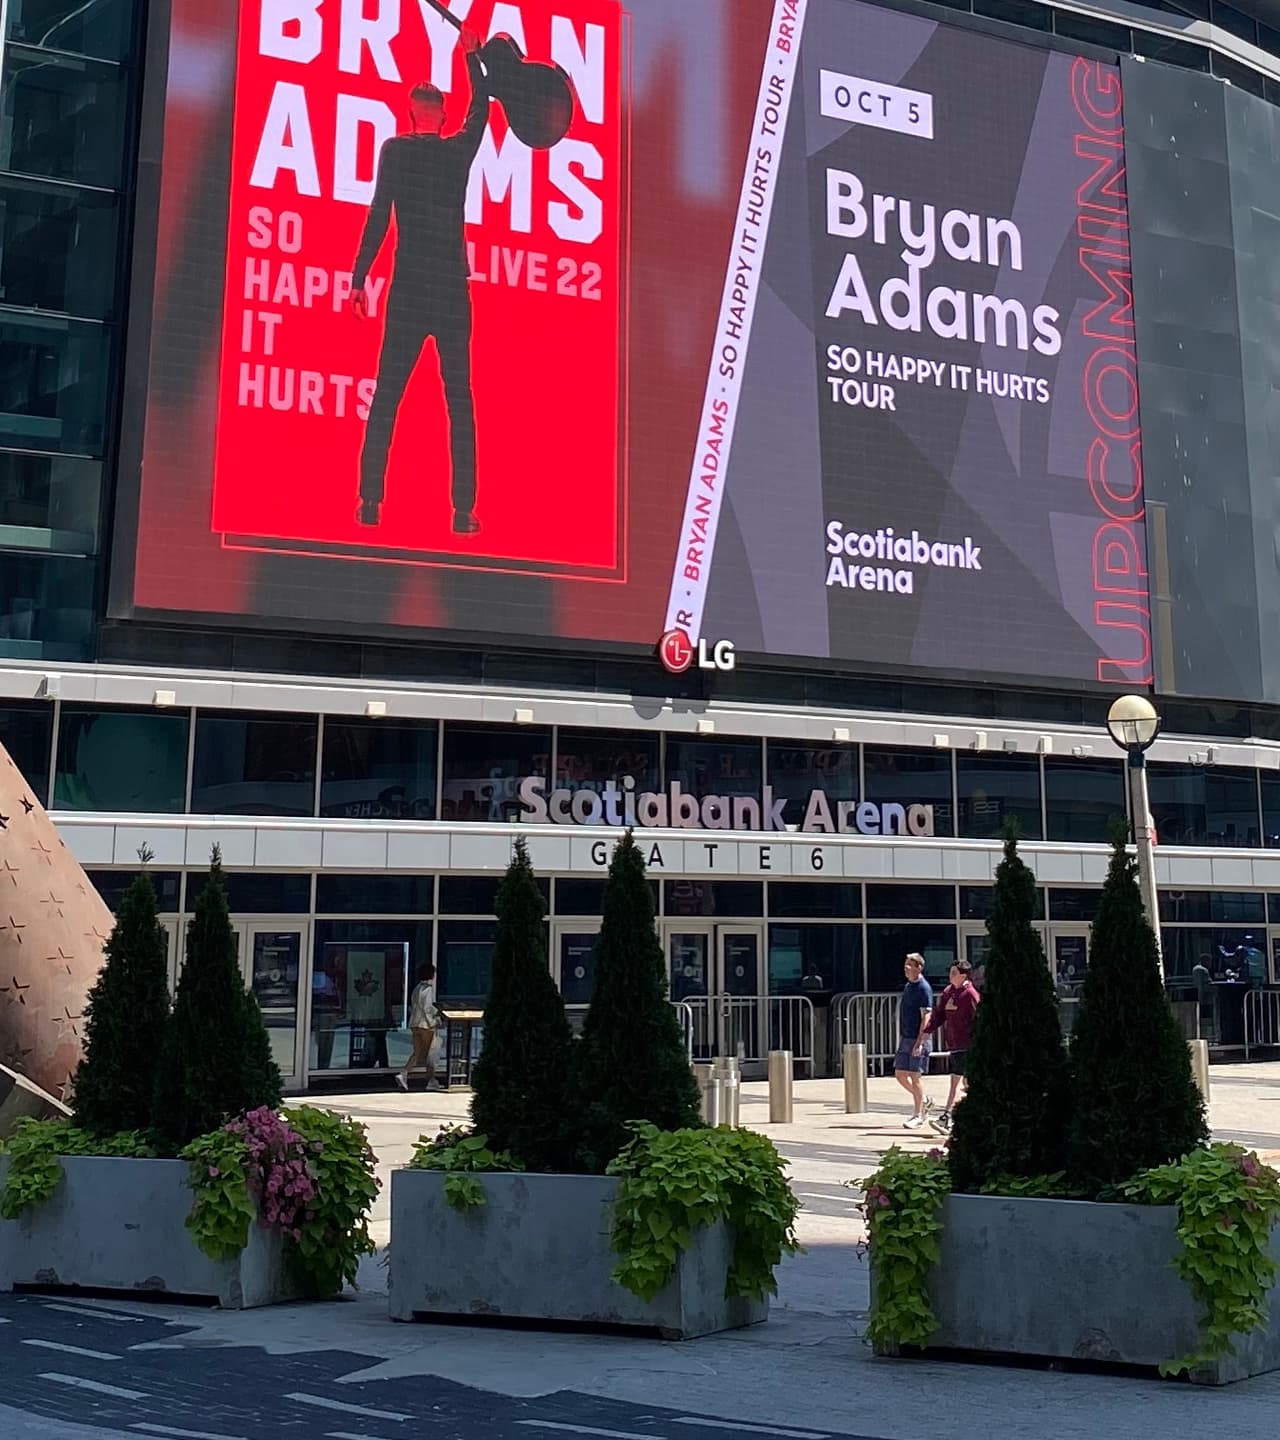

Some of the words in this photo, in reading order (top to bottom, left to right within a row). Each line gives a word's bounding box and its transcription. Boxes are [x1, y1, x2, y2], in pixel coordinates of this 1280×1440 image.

[761, 74, 785, 137] TOUR
[834, 85, 892, 119] OCT
[907, 102, 921, 124] 5
[249, 80, 604, 245] ADMS
[745, 147, 772, 227] HURTS
[247, 205, 303, 254] SO
[742, 229, 758, 254] IT
[826, 168, 1023, 270] Bryan
[243, 256, 386, 318] HAPPY
[466, 240, 549, 292] LIVE
[557, 257, 602, 301] 22
[725, 256, 754, 340] HAPPY
[241, 310, 282, 356] IT
[825, 253, 1062, 356] Adams
[237, 363, 378, 421] HURTS
[719, 344, 738, 380] SO
[827, 344, 861, 373] SO
[866, 350, 946, 387] HAPPY
[950, 364, 971, 391] IT
[976, 368, 1050, 404] HURTS
[1071, 56, 1155, 686] UPCOMING
[827, 376, 896, 411] TOUR
[700, 398, 729, 492] ADAMS
[683, 494, 713, 582] BRYAN
[826, 520, 982, 570] Scotiabank
[826, 556, 913, 594] Arena
[698, 638, 736, 671] LG
[519, 774, 788, 832] Scotiabank
[802, 788, 936, 837] Arena
[590, 840, 772, 871] GATE
[811, 846, 824, 872] 6
